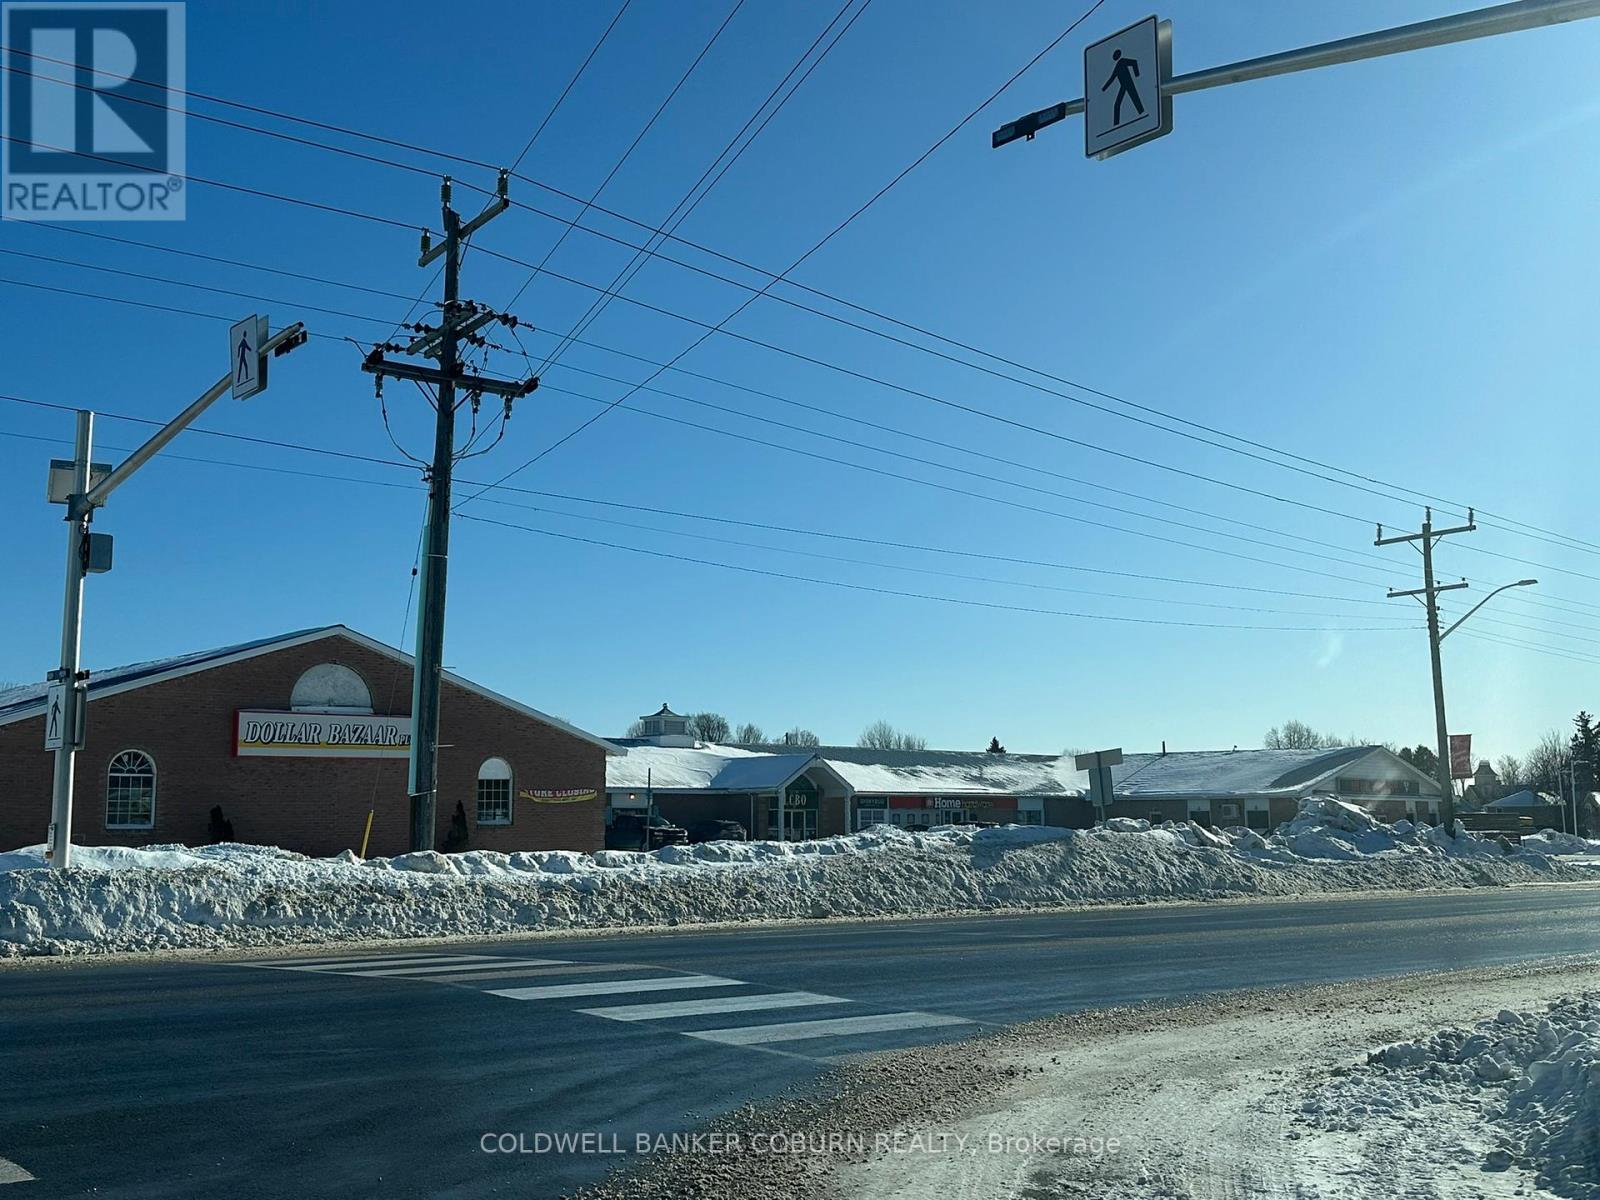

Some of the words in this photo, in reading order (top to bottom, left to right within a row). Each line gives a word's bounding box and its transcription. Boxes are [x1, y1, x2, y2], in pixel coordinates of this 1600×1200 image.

[245, 721, 321, 744] DOLLAR
[327, 724, 398, 746] BAZAAR
[934, 797, 961, 809] Home
